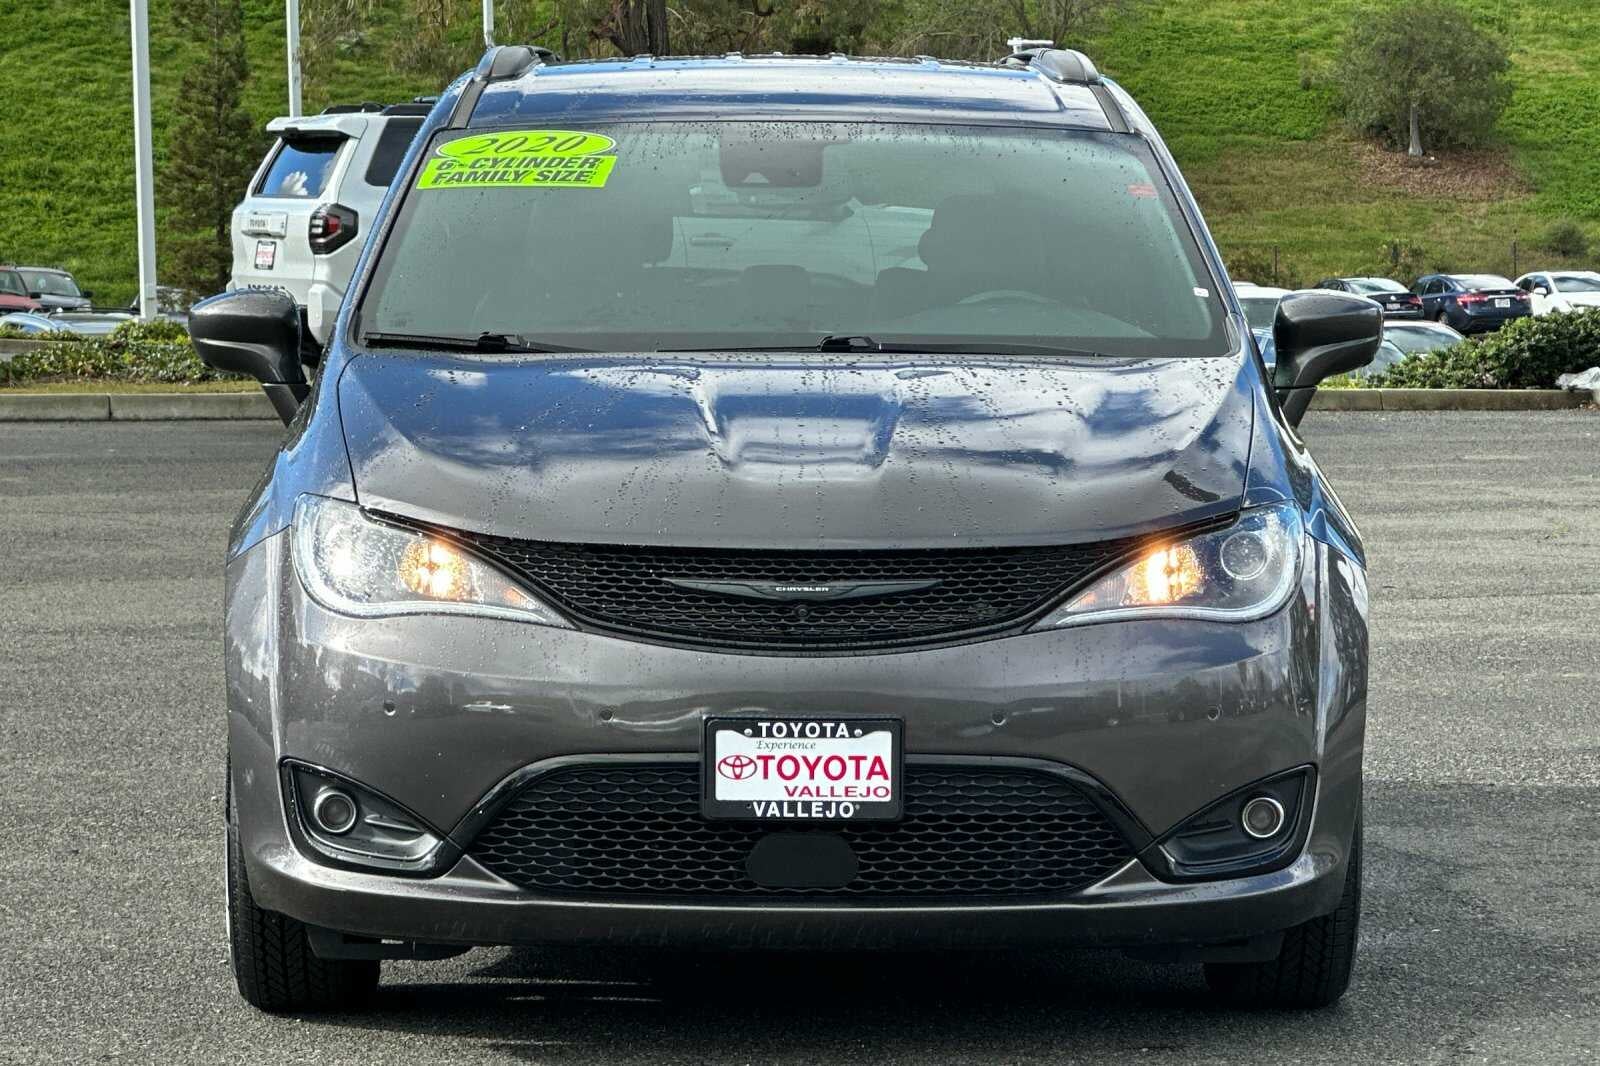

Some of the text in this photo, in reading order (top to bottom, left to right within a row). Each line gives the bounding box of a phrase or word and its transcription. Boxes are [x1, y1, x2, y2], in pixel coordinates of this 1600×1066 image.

[461, 135, 588, 154] 2020
[432, 170, 594, 184] FAMILY SIZE
[758, 722, 849, 738] TOYOTA
[756, 740, 816, 752] Experience
[756, 755, 889, 780] TOYOTA
[784, 785, 890, 798] VALLEJO
[752, 801, 854, 818] VALLEJO
